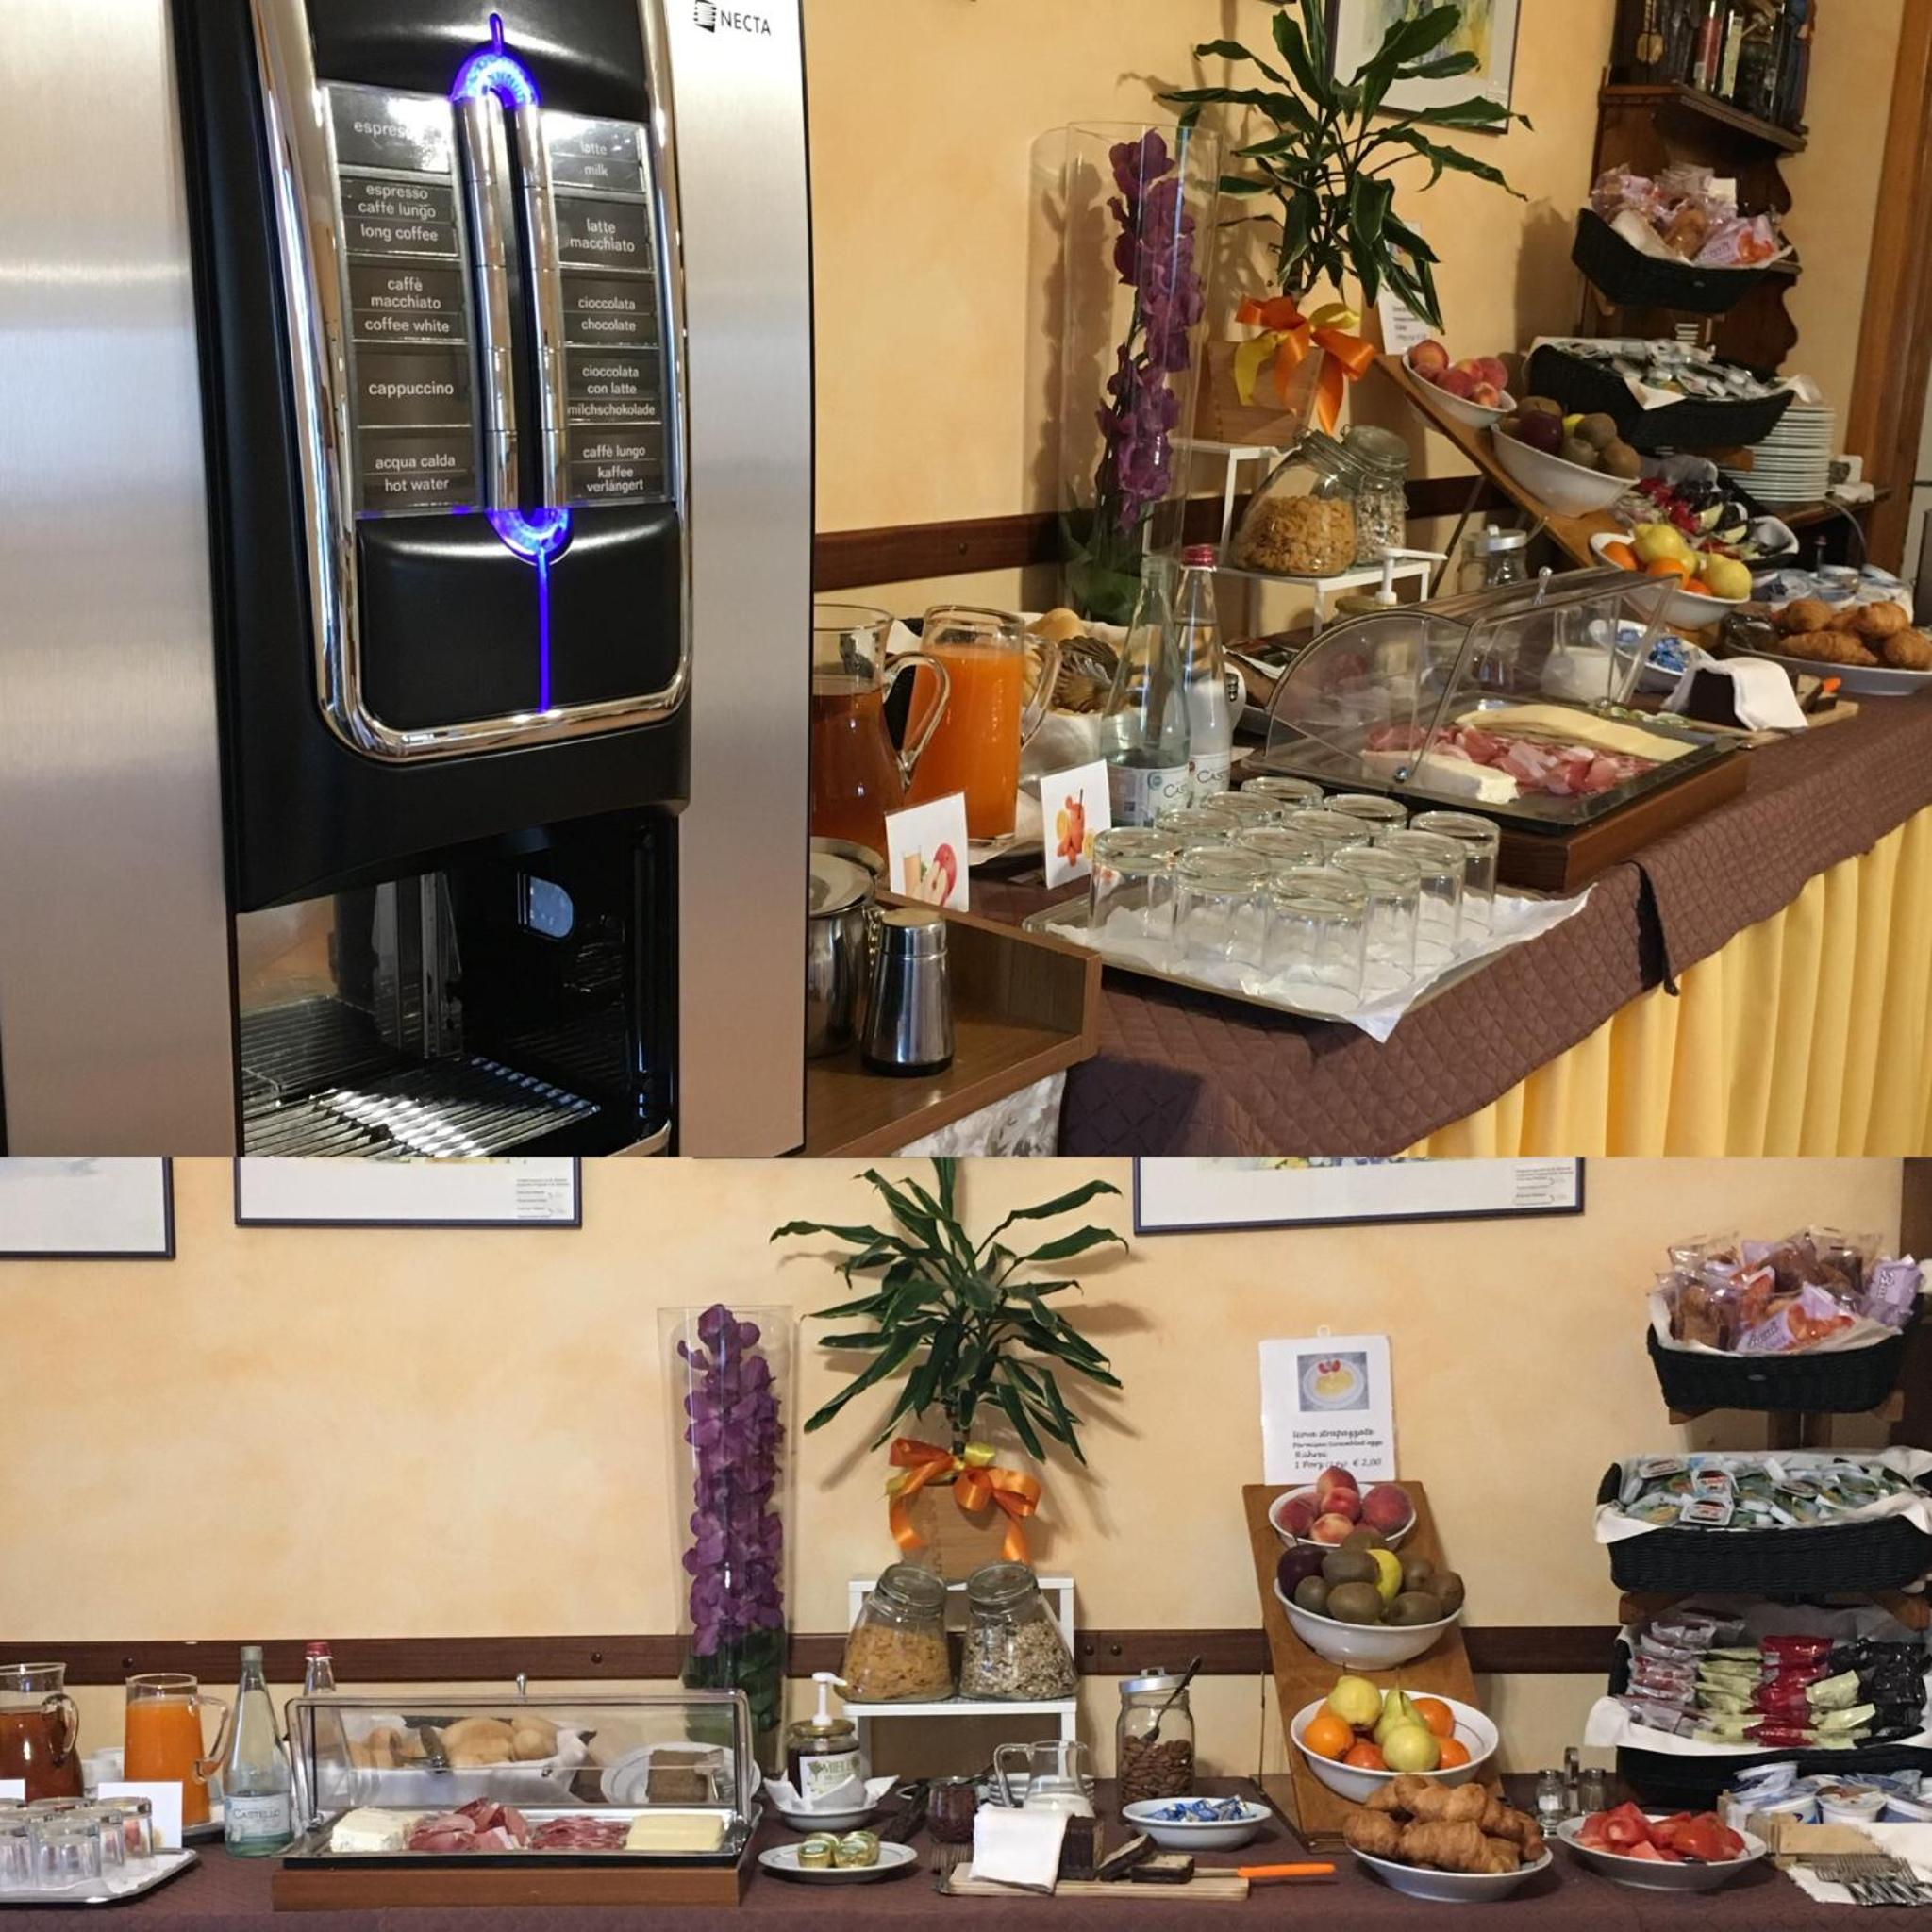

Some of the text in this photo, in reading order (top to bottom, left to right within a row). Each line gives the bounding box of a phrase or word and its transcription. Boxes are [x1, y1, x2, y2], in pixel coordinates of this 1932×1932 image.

[720, 9, 772, 36] NECTA
[353, 120, 409, 139] espres
[584, 163, 608, 176] milk
[365, 184, 428, 200] espresso
[399, 203, 437, 221] lungo
[360, 223, 439, 242] long coffee
[586, 217, 617, 234] latte
[570, 235, 636, 252] macchiato
[370, 294, 442, 310] macchiato
[577, 295, 636, 310] cioccolata
[364, 316, 450, 333] coffee white
[581, 317, 637, 332] chocolate
[582, 364, 640, 378] cioccolata
[368, 380, 455, 399] cappuccino
[587, 381, 638, 395] con latte
[567, 402, 656, 417] milchschokolade
[616, 444, 646, 459] lungo
[375, 453, 456, 473] acqua calda
[597, 464, 635, 479] kaffee
[384, 477, 450, 492] hot water
